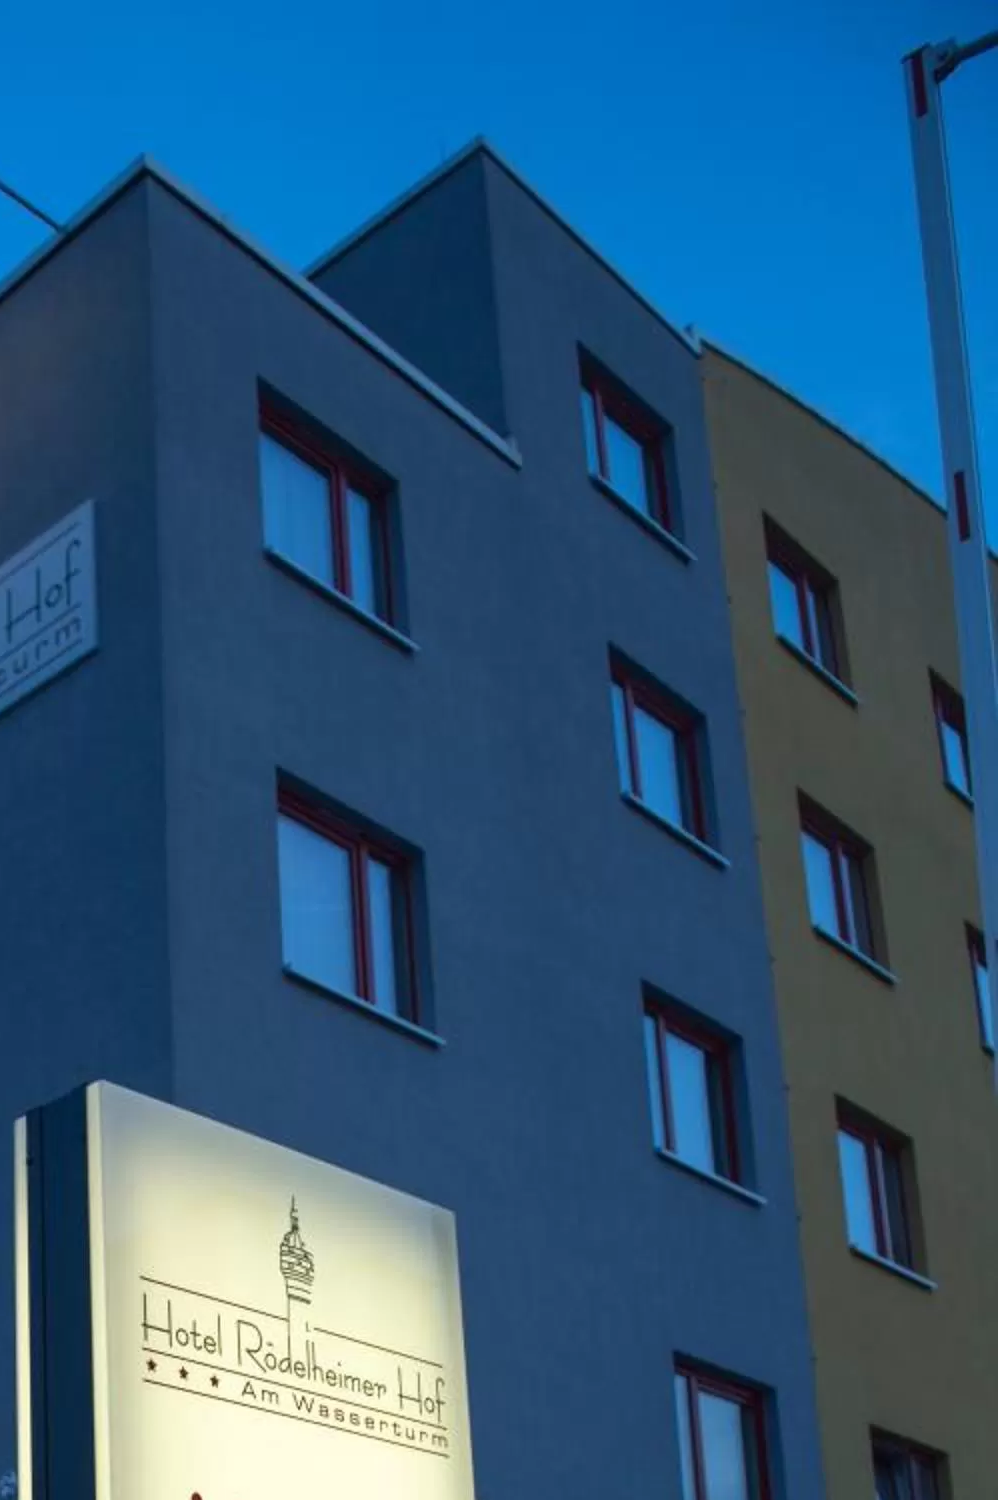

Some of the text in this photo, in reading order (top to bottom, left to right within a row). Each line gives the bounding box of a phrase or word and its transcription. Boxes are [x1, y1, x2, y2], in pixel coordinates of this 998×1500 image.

[6, 538, 82, 643] Hof
[141, 1291, 447, 1423] Hotel Rödelheimer Hof
[241, 1380, 449, 1449] Am Wasserturm
